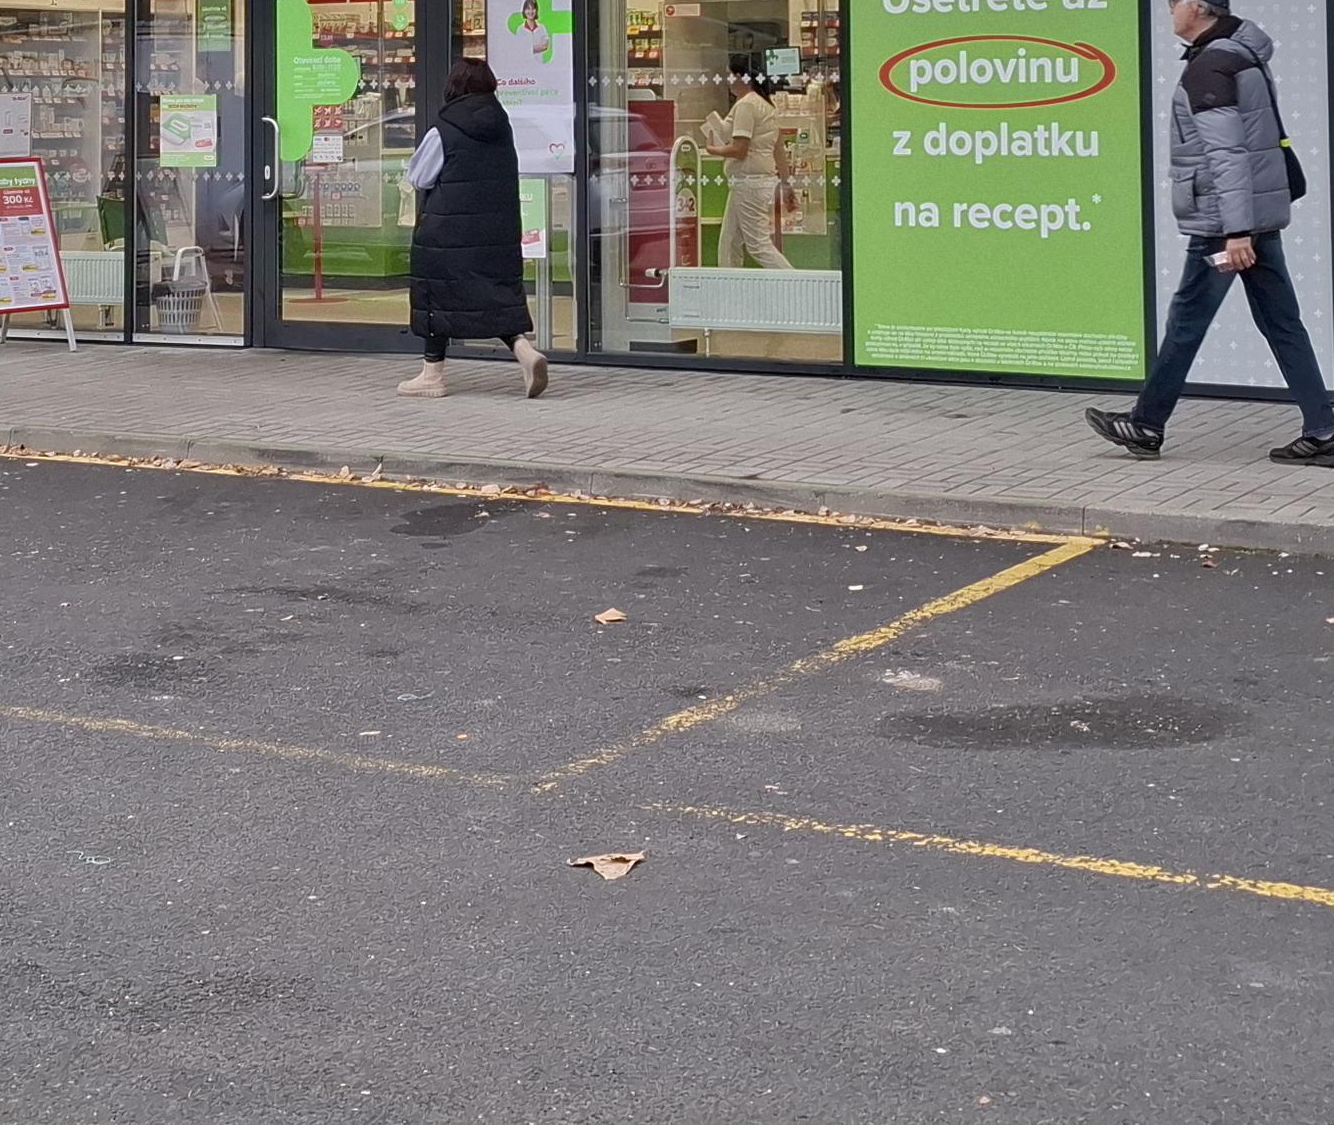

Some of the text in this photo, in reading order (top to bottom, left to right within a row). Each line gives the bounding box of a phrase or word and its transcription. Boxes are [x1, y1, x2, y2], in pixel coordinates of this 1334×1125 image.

[909, 48, 1079, 93] polovinu
[892, 122, 1099, 164] z doplatku
[3, 195, 22, 205] 300
[894, 201, 940, 227] na
